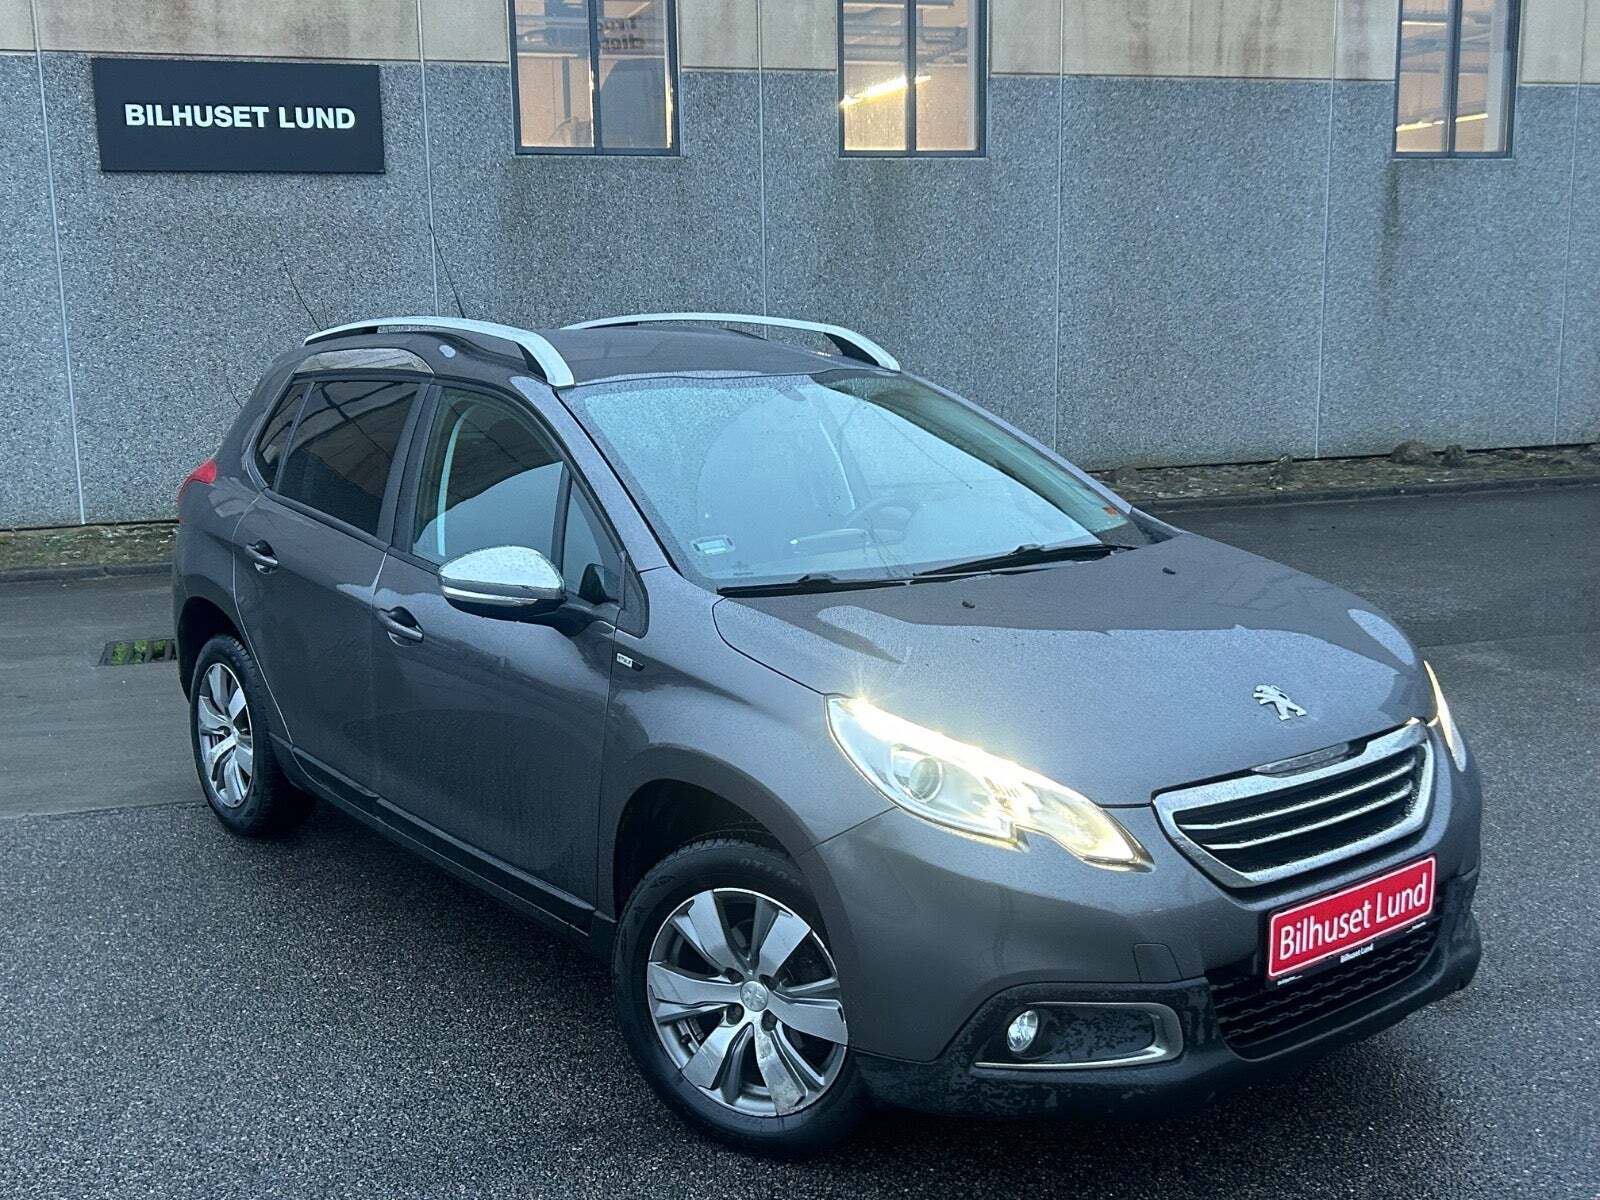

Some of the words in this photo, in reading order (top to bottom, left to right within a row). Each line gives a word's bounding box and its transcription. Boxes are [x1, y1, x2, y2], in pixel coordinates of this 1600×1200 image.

[124, 103, 269, 128] BILHUSET
[278, 106, 356, 129] LUND
[1279, 899, 1372, 961] Bilhuset
[1375, 872, 1428, 924] Lund
